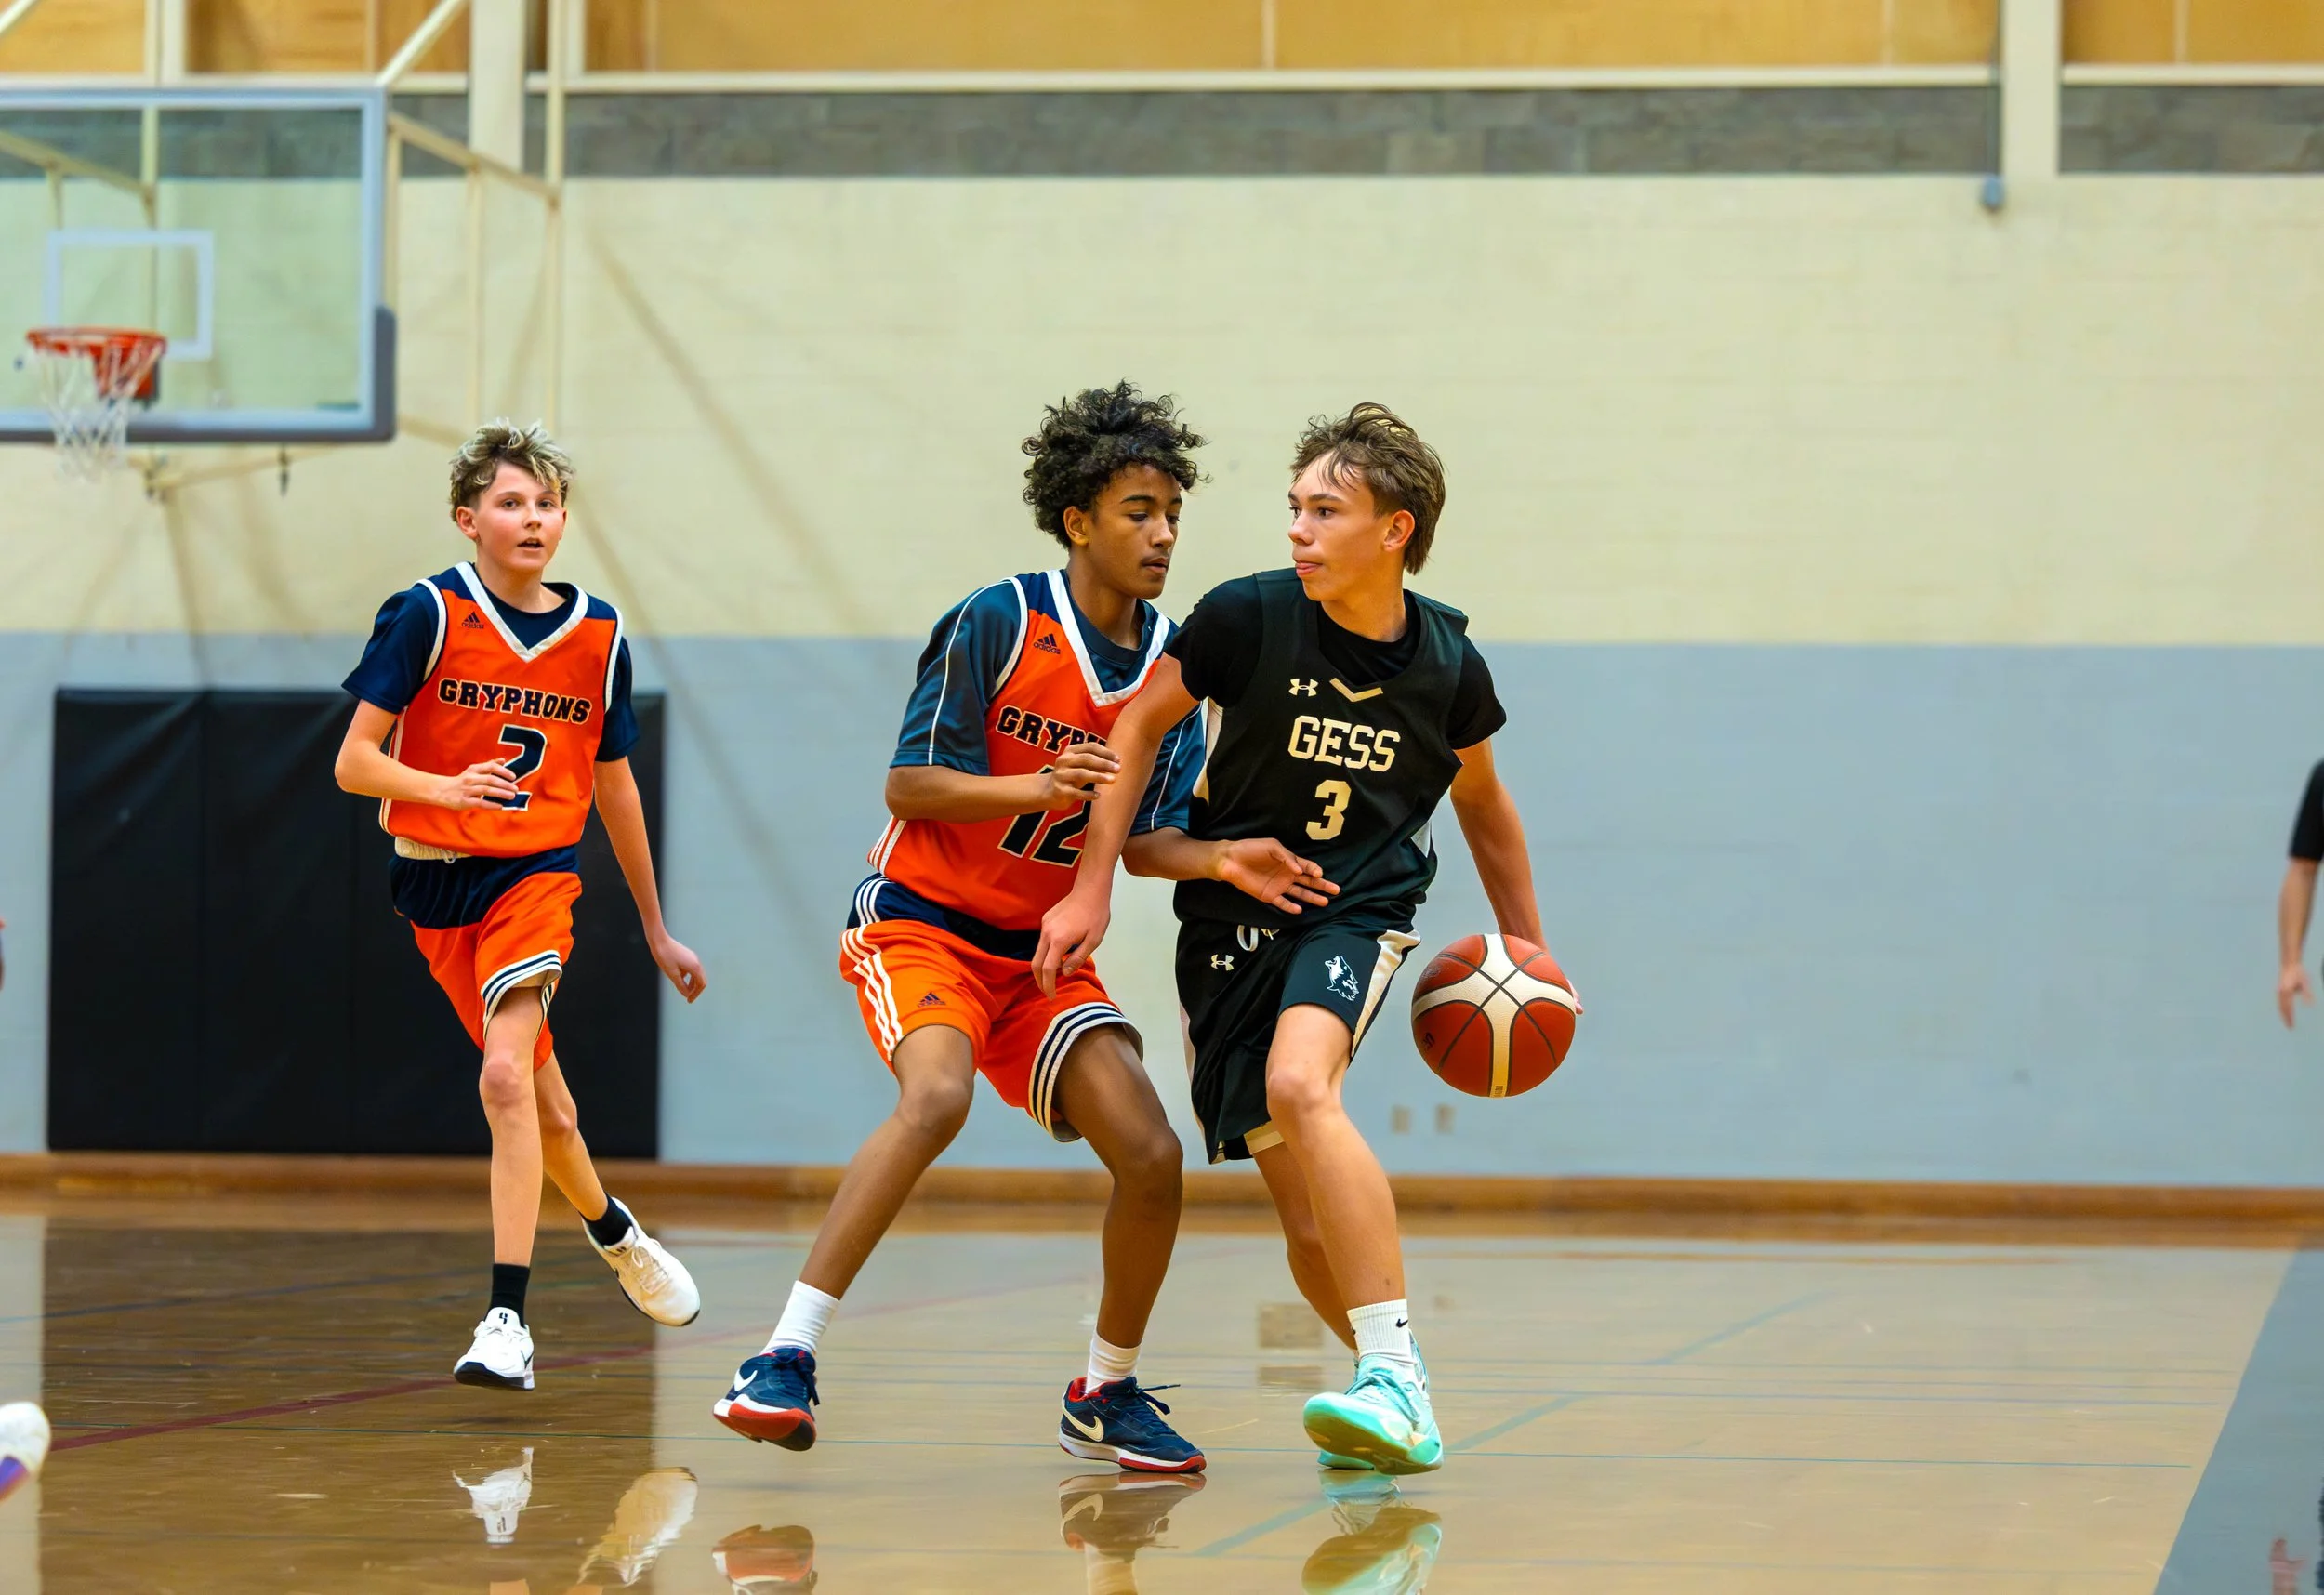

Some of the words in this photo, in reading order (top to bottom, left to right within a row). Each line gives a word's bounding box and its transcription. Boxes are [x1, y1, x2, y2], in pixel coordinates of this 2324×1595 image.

[1034, 641, 1061, 655] adidas
[438, 677, 593, 725] GRYPHONS
[482, 723, 548, 811] 2
[1287, 715, 1401, 772] GESS
[1305, 779, 1352, 841] 3
